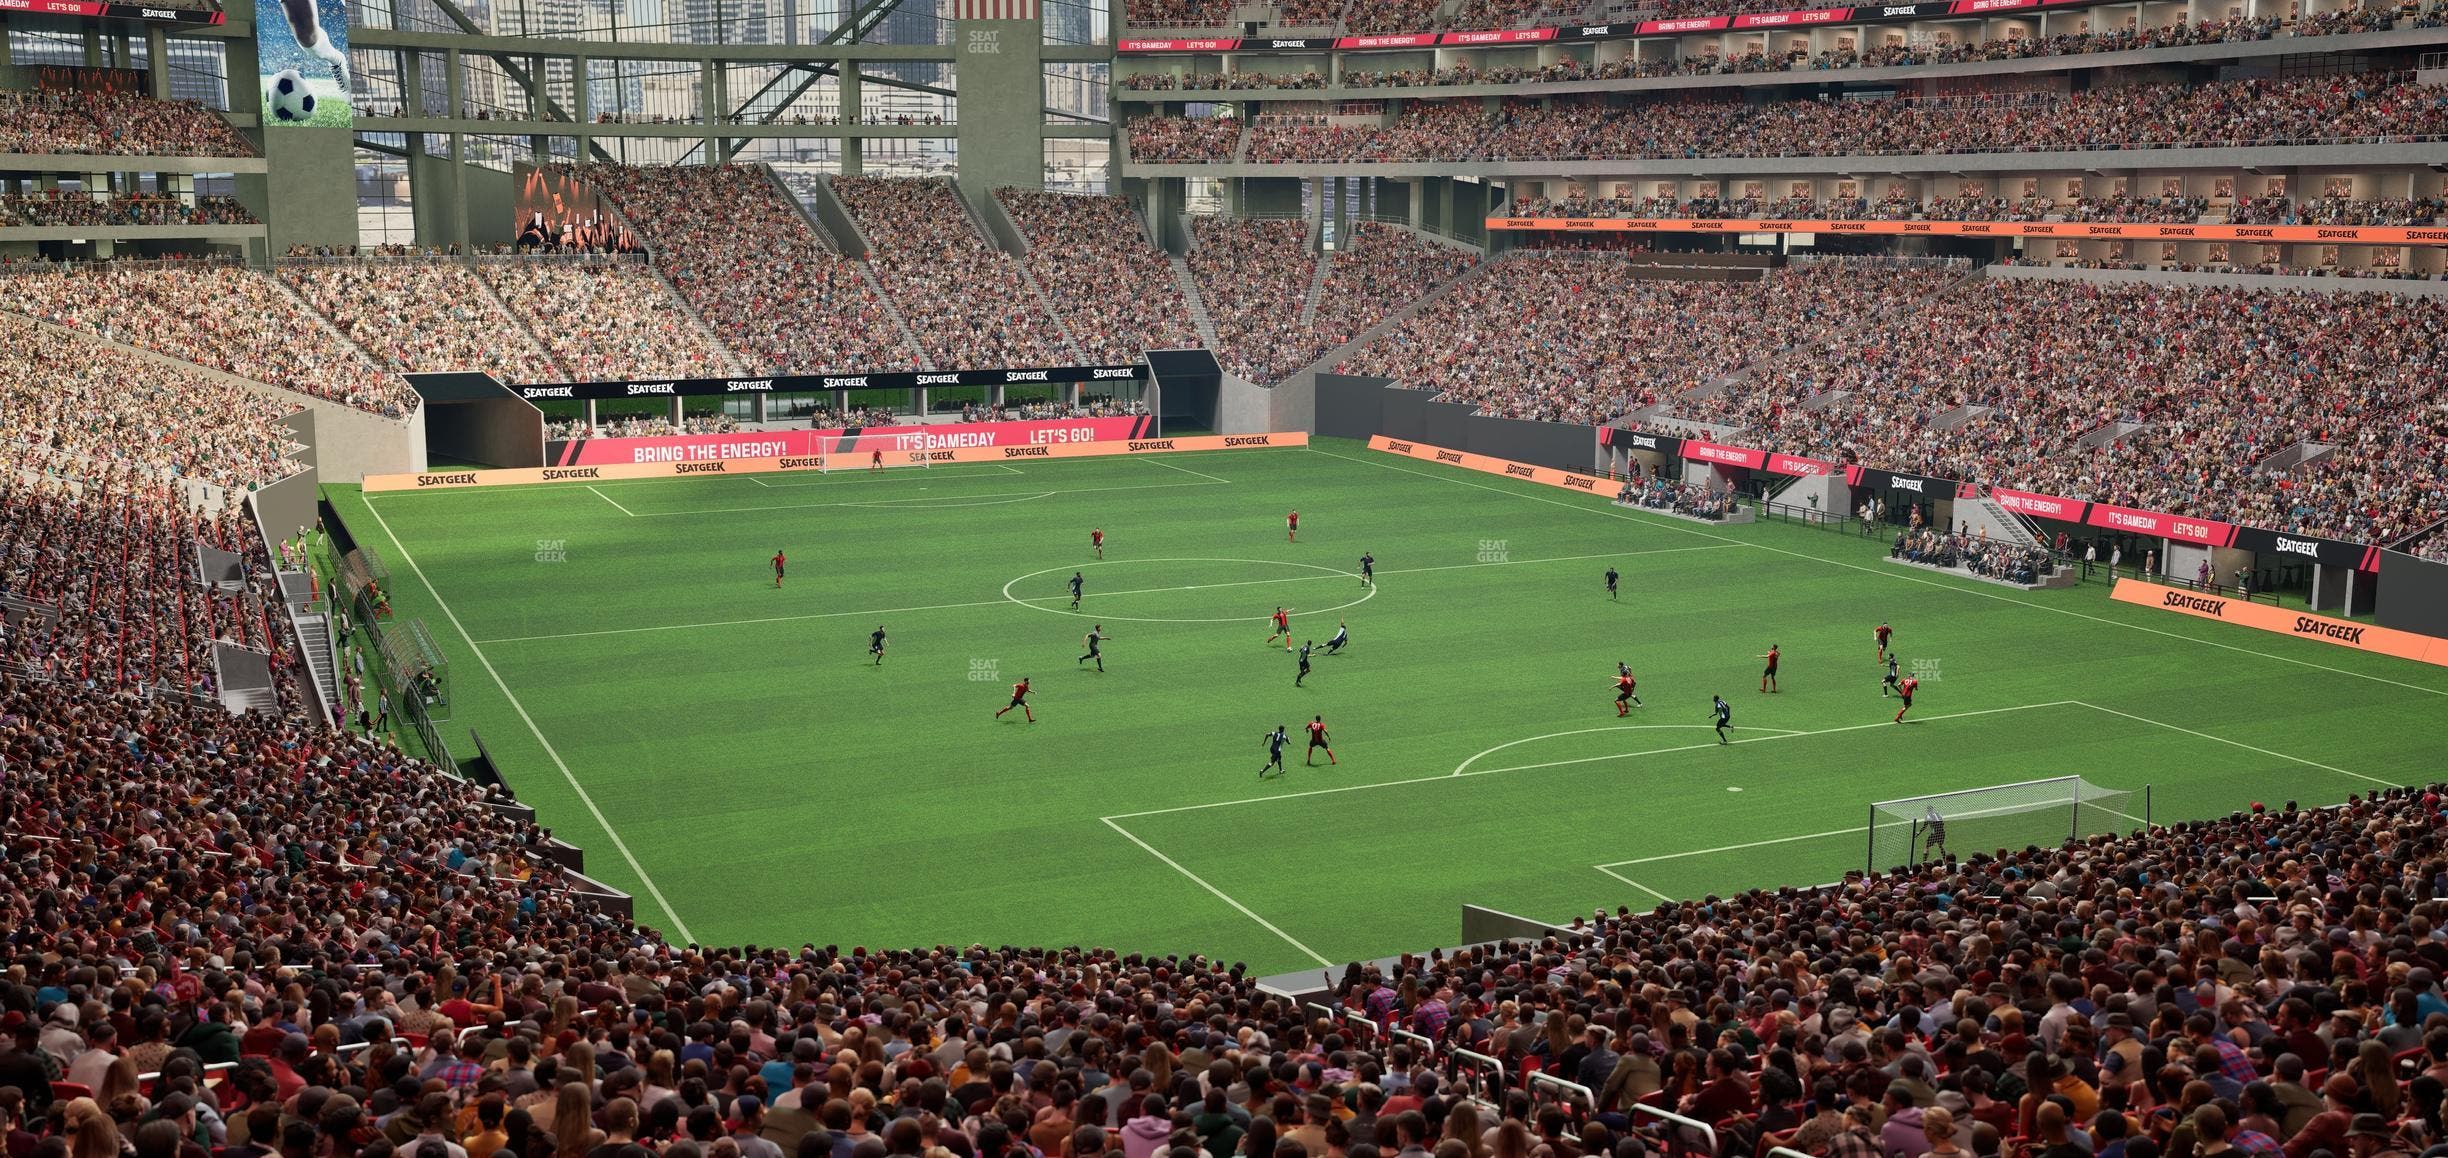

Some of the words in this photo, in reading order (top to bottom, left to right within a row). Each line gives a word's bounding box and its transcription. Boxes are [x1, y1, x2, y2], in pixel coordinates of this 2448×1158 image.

[68, 4, 80, 12] GO!
[1884, 5, 1915, 16] SEATGEEK
[142, 9, 176, 19] SEATGEEK
[1761, 15, 1789, 24] GAMEDAY
[1803, 13, 1818, 21] LET'S
[1820, 12, 1830, 20] GO!
[1582, 26, 1608, 36] SEATGEEK
[1359, 38, 1377, 46] BRING
[1390, 37, 1416, 45] ENERGY!
[1458, 34, 1470, 42] IT'S
[1471, 33, 1500, 41] GAMEDAY
[1515, 32, 1530, 40] LET'S
[1273, 40, 1305, 48] SEATGEEK
[2024, 225, 2053, 233] SEATGEEK
[2090, 226, 2121, 234] SEATGEEK
[2160, 228, 2194, 236] SEATGEEK
[2236, 228, 2273, 237] SEATGEEK
[2318, 230, 2358, 238] SEATGEEK
[1006, 371, 1048, 381] SEATGEEK
[1094, 368, 1133, 378] SEATGEEK
[824, 377, 868, 388] SEATGEEK
[917, 374, 959, 384] SEATGEEK
[627, 383, 675, 394] SEATGEEK
[727, 380, 773, 392] SEATGEEK
[523, 386, 573, 399] SEATGEEK
[897, 435, 923, 450] IT'S
[927, 432, 995, 449] GAMEDAY
[1030, 429, 1067, 444] LET'S
[1071, 427, 1094, 442] GO!
[1225, 436, 1269, 446] SEATGEEK
[1633, 434, 1656, 449] SEATGEEK
[1128, 440, 1174, 451] SEATGEEK
[1388, 441, 1412, 454] SEATGEEK
[635, 446, 683, 463] BRING
[688, 445, 717, 460] THE
[722, 441, 786, 458] ENERGY!
[910, 451, 955, 462] SEATGEEK
[1005, 446, 1049, 457] SEATGEEK
[1437, 450, 1463, 464] SEATGEEK
[1716, 449, 1725, 459] THE
[676, 462, 725, 473] SEATGEEK
[1506, 464, 1535, 479] SEATGEEK
[418, 473, 477, 486] SEATGEEK
[543, 468, 599, 480] SEATGEEK
[1564, 475, 1596, 490] SEATGEEK
[1892, 475, 1923, 493] SEATGEEK
[2021, 498, 2033, 510] THE
[2034, 500, 2062, 514] ENERGY!
[2108, 512, 2122, 524] IT'S
[2123, 514, 2157, 529] GAMEDAY
[2173, 522, 2193, 536] LET'S
[2194, 525, 2208, 538] GO!
[2276, 536, 2318, 558] SEATGEEK
[2164, 591, 2226, 617] SEATGEEK
[2294, 616, 2365, 644] SEATGEEK
